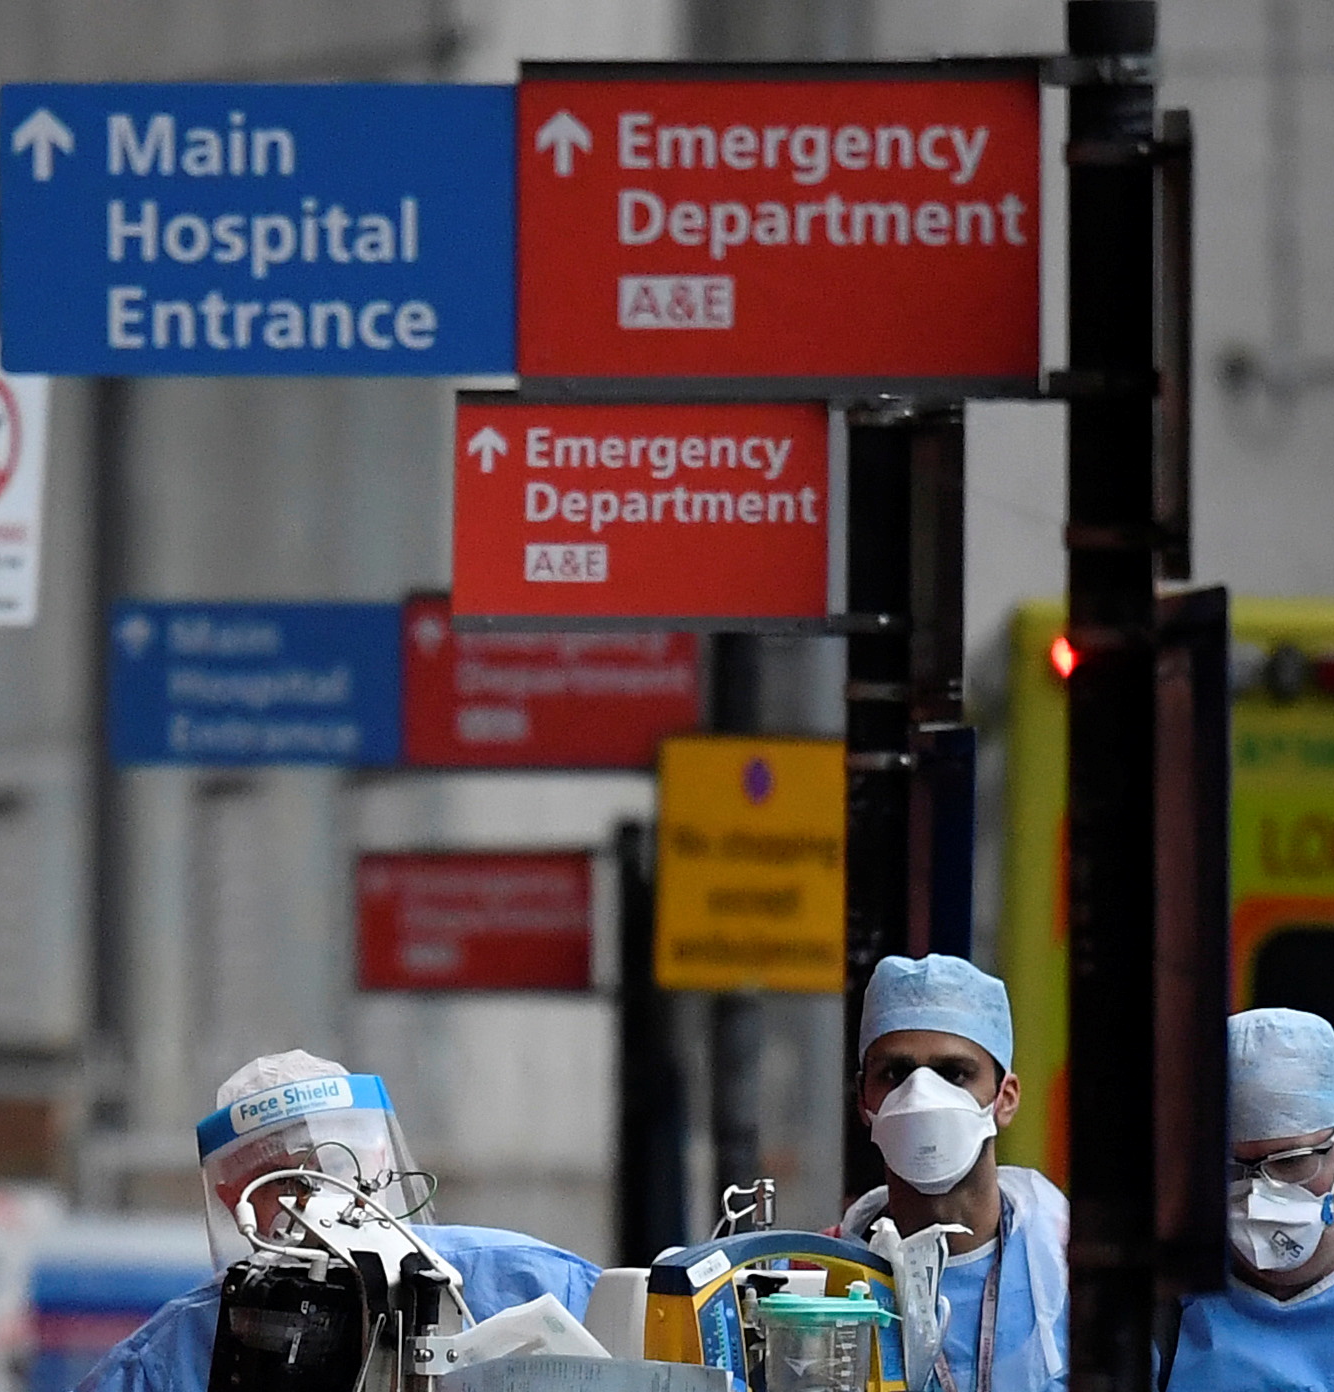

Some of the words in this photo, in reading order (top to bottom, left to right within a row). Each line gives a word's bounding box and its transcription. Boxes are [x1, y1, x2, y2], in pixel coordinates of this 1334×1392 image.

[107, 110, 295, 177] Main
[617, 112, 989, 185] Emergency
[107, 197, 419, 280] Hospital
[617, 189, 1028, 260] Department
[107, 285, 438, 350] Entrance
[626, 282, 729, 323] A&E
[524, 427, 792, 479] Emergency
[524, 482, 819, 532] Department
[532, 548, 601, 577] A&E
[240, 1097, 278, 1120] Face
[283, 1081, 339, 1104] Shield
